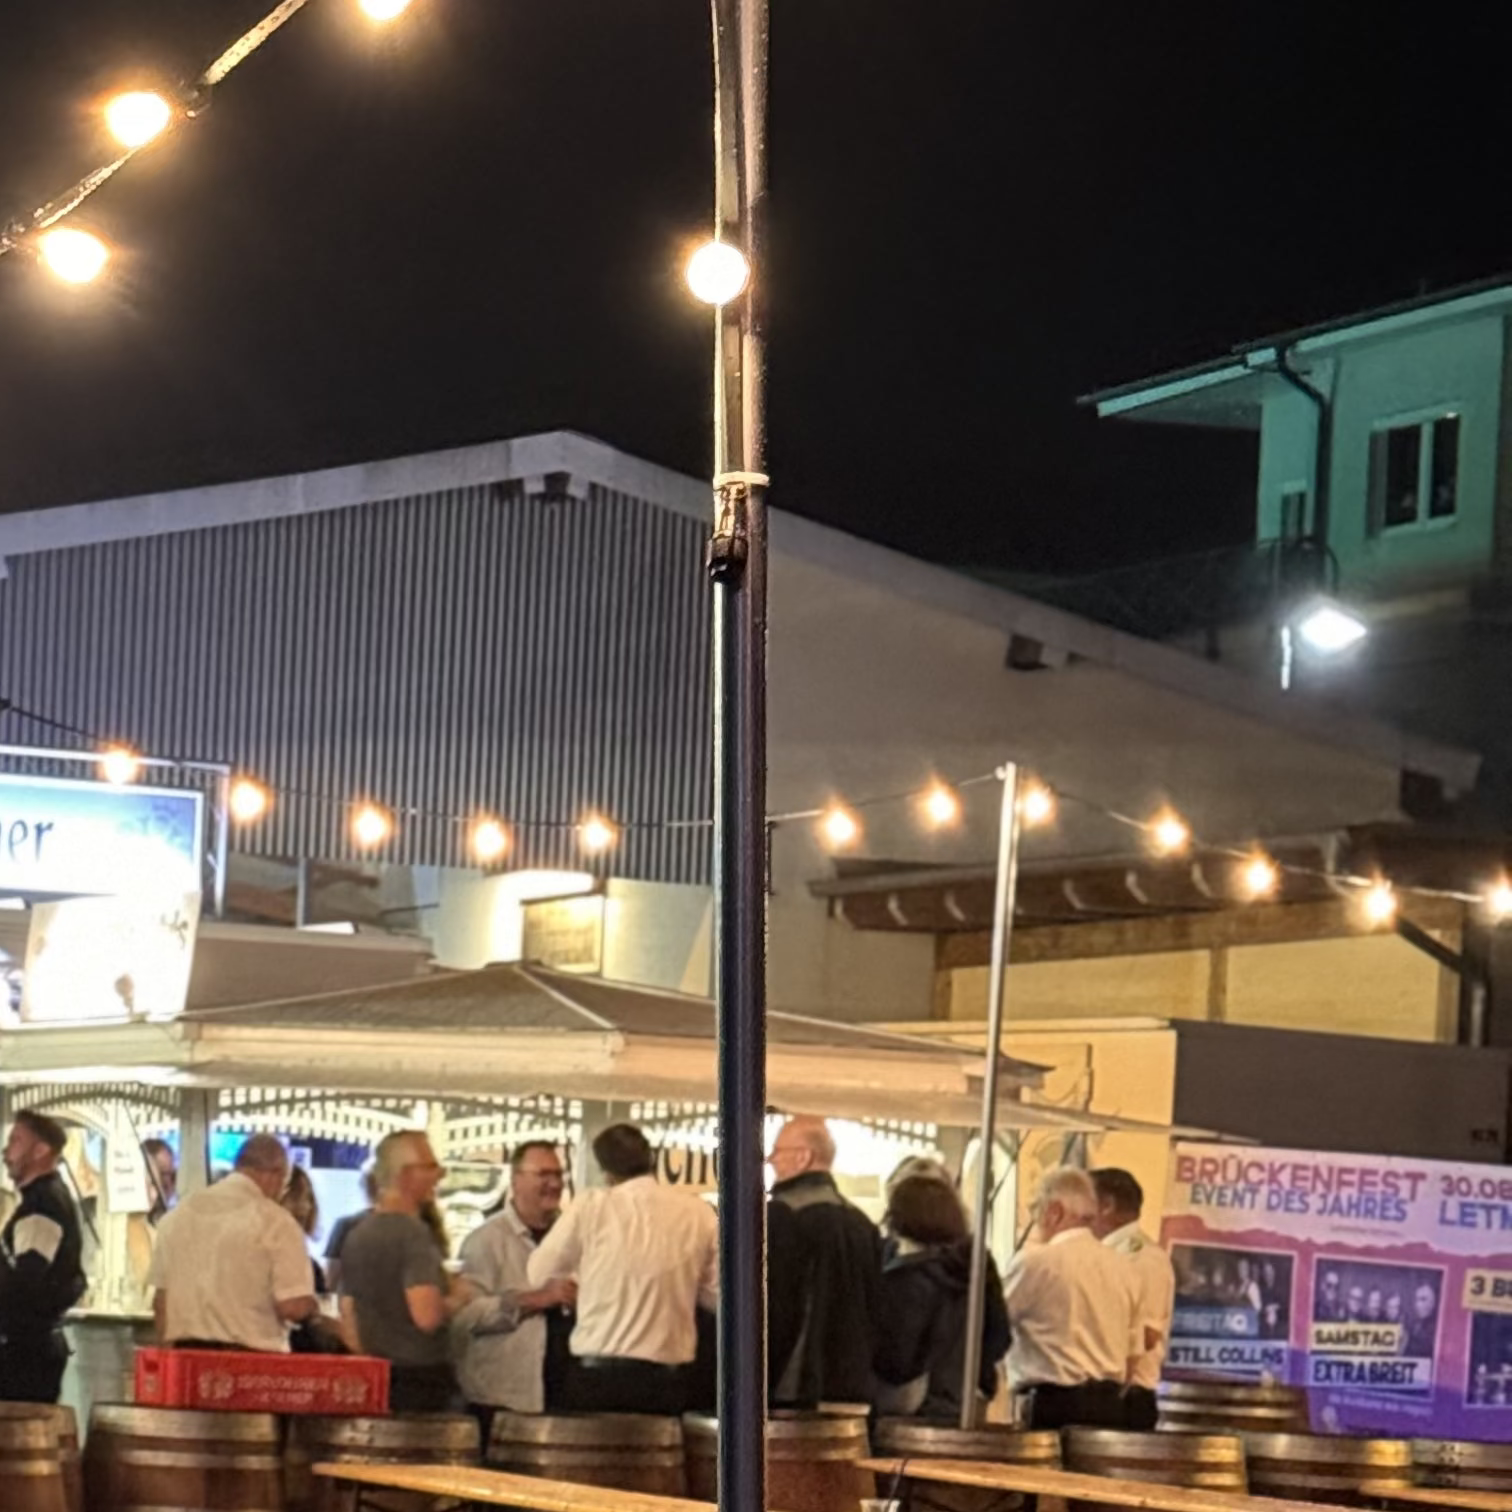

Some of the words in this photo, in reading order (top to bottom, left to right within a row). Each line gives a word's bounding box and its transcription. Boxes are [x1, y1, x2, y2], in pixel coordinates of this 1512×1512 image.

[1174, 1153, 1428, 1203] BRÜCKENFEST
[1190, 1182, 1260, 1209] EVENT
[1266, 1188, 1310, 1214] DES
[1316, 1193, 1408, 1222] JAHRES
[1470, 1275, 1486, 1295] 3
[1315, 1329, 1396, 1347] SAMSTAG
[1170, 1346, 1215, 1364] STILL
[1218, 1346, 1284, 1365] COLLINS
